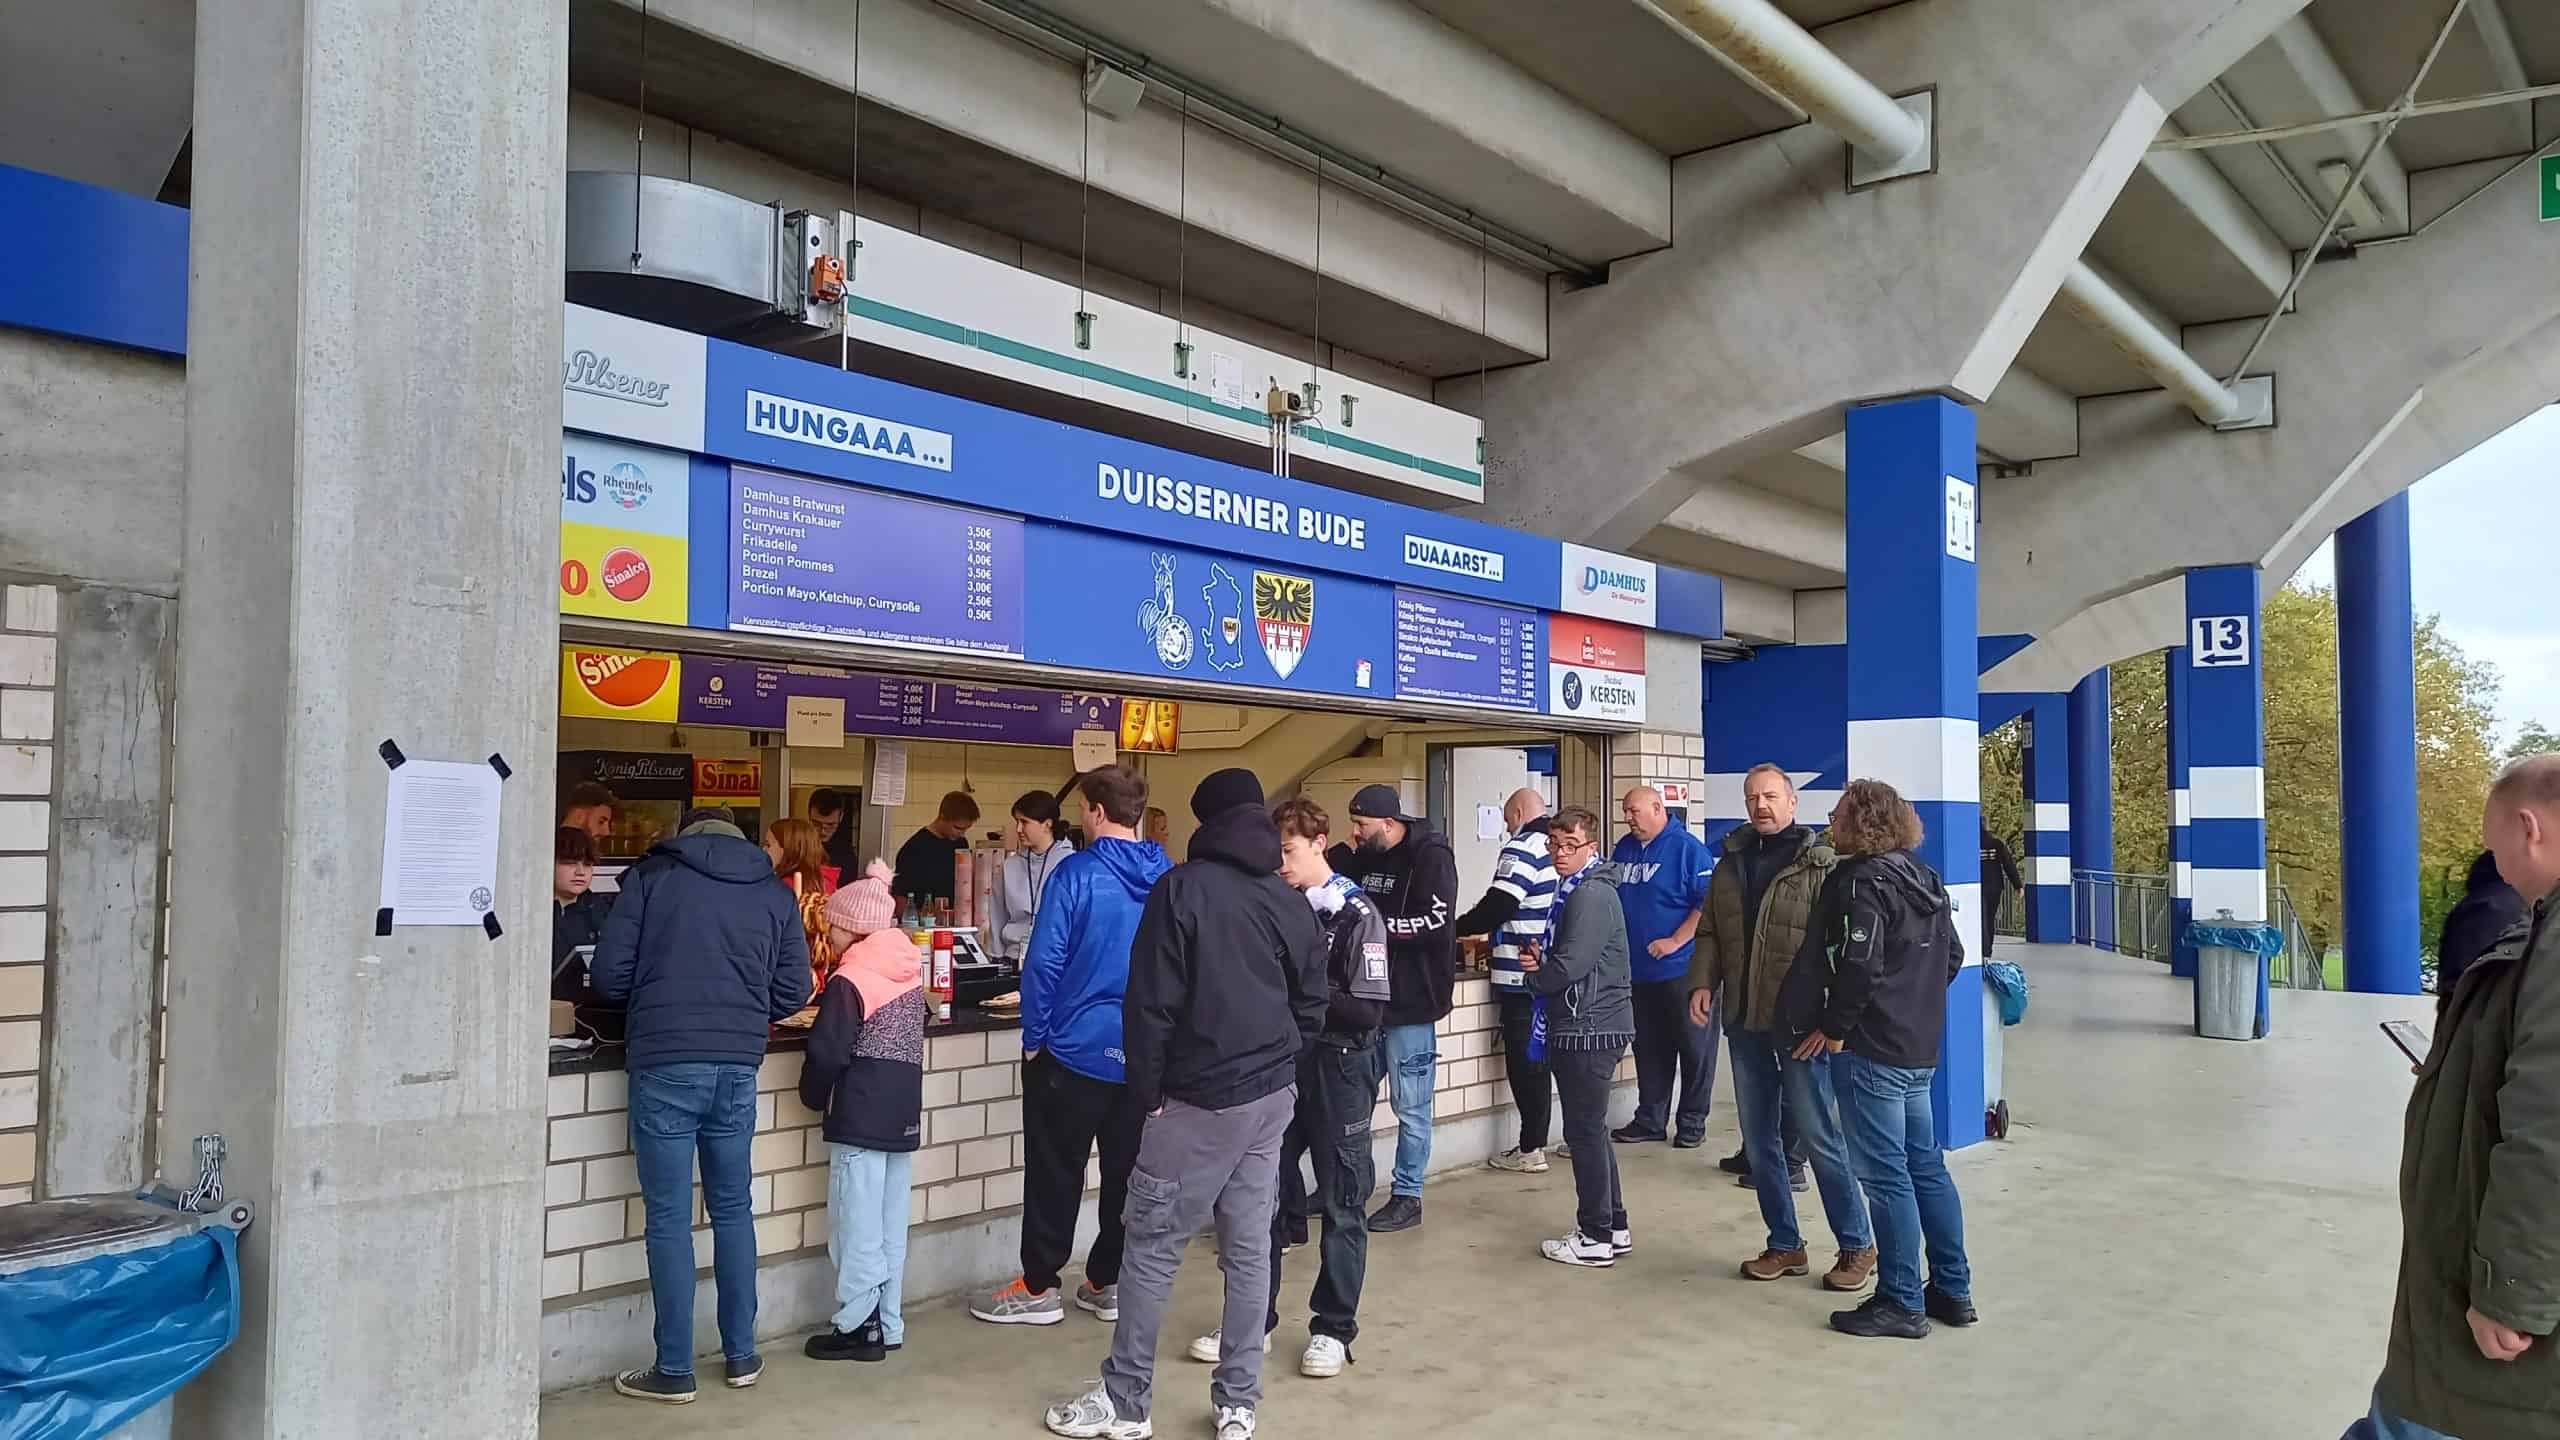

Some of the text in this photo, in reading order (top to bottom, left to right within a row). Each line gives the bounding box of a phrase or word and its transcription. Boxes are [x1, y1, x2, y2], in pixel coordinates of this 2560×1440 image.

[743, 487, 789, 505] Damhus
[793, 496, 845, 515] Bratwurst
[1098, 463, 1366, 549] DUISSERNER BUDE
[743, 503, 789, 521] Damhus
[793, 511, 842, 529] Krakauer
[743, 518, 806, 539] Currywurst
[743, 534, 798, 552] Frikadelle
[743, 549, 784, 566] Portion
[787, 556, 834, 573] Pommes
[743, 565, 778, 580] Brezel
[604, 560, 646, 589] Sinalco
[743, 581, 784, 596] Portion
[2199, 618, 2242, 651] 13
[1590, 685, 1636, 706] KERSTEN
